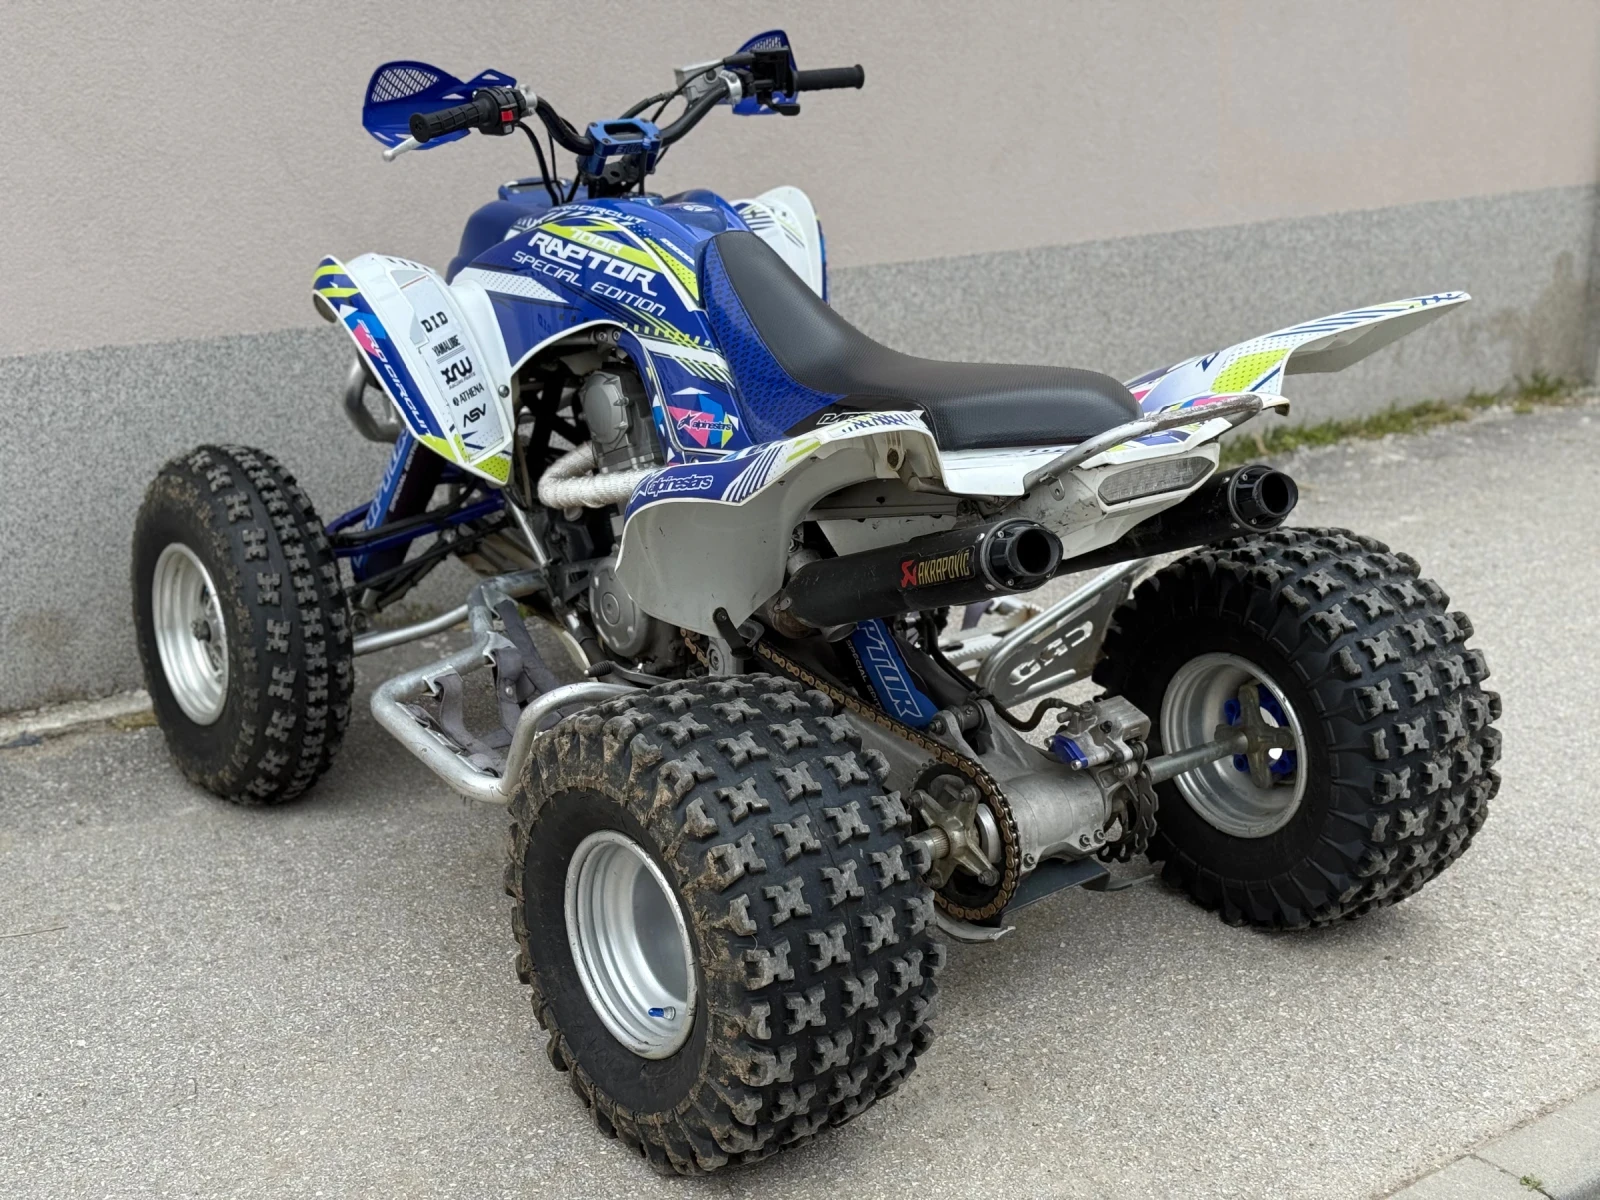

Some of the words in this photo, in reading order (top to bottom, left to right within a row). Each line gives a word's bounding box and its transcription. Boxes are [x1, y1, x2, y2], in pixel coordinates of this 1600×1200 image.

[579, 205, 647, 224] CIRCUIT
[511, 250, 583, 287] SPECIAL
[590, 281, 667, 317] EDITION
[528, 232, 658, 297] RAPTOR
[432, 334, 461, 357] YAMALUBE
[384, 363, 437, 443] CIRCUIT
[459, 382, 485, 405] ATHENA
[463, 402, 487, 429] ASV
[855, 618, 924, 718] PTOR
